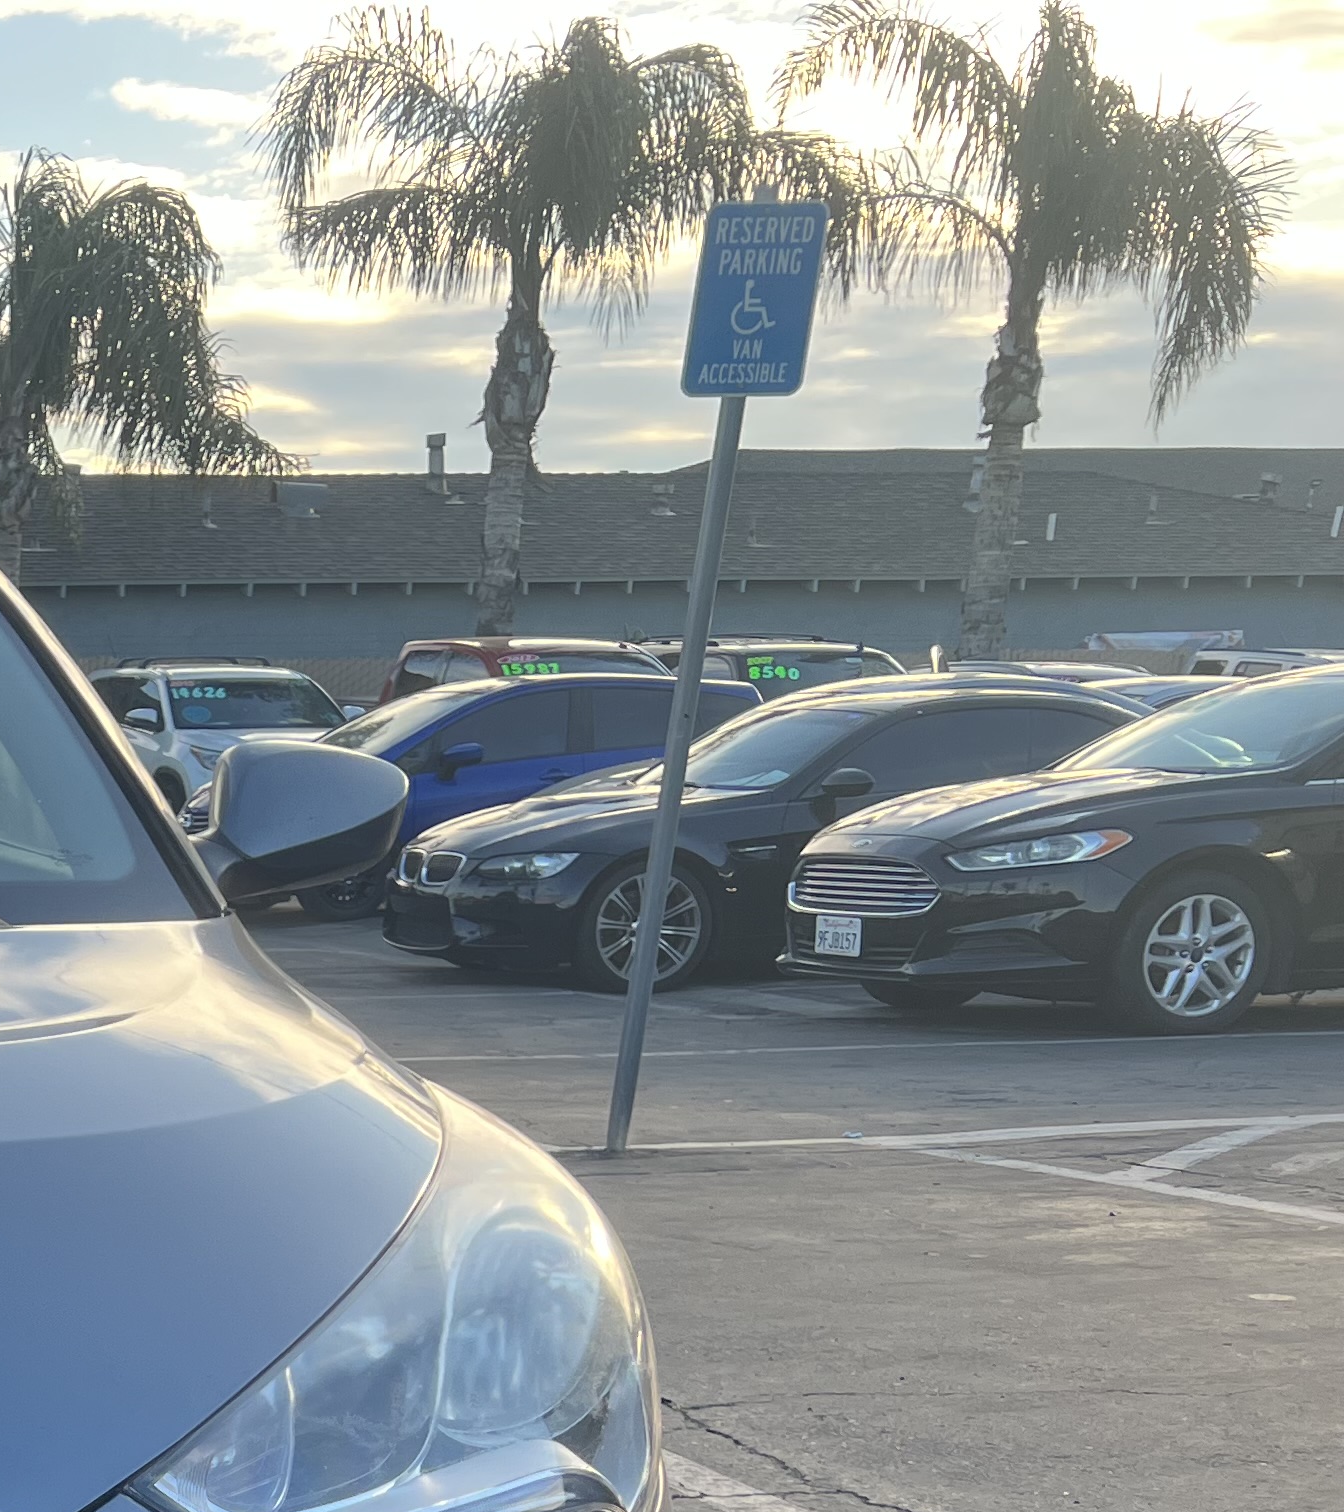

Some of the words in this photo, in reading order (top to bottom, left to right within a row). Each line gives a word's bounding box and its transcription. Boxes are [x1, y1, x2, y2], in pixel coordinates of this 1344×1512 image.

[715, 216, 815, 245] RESERVED
[718, 247, 803, 276] PARKING
[732, 338, 763, 360] VAN
[698, 362, 788, 385] ACCESSIBLE
